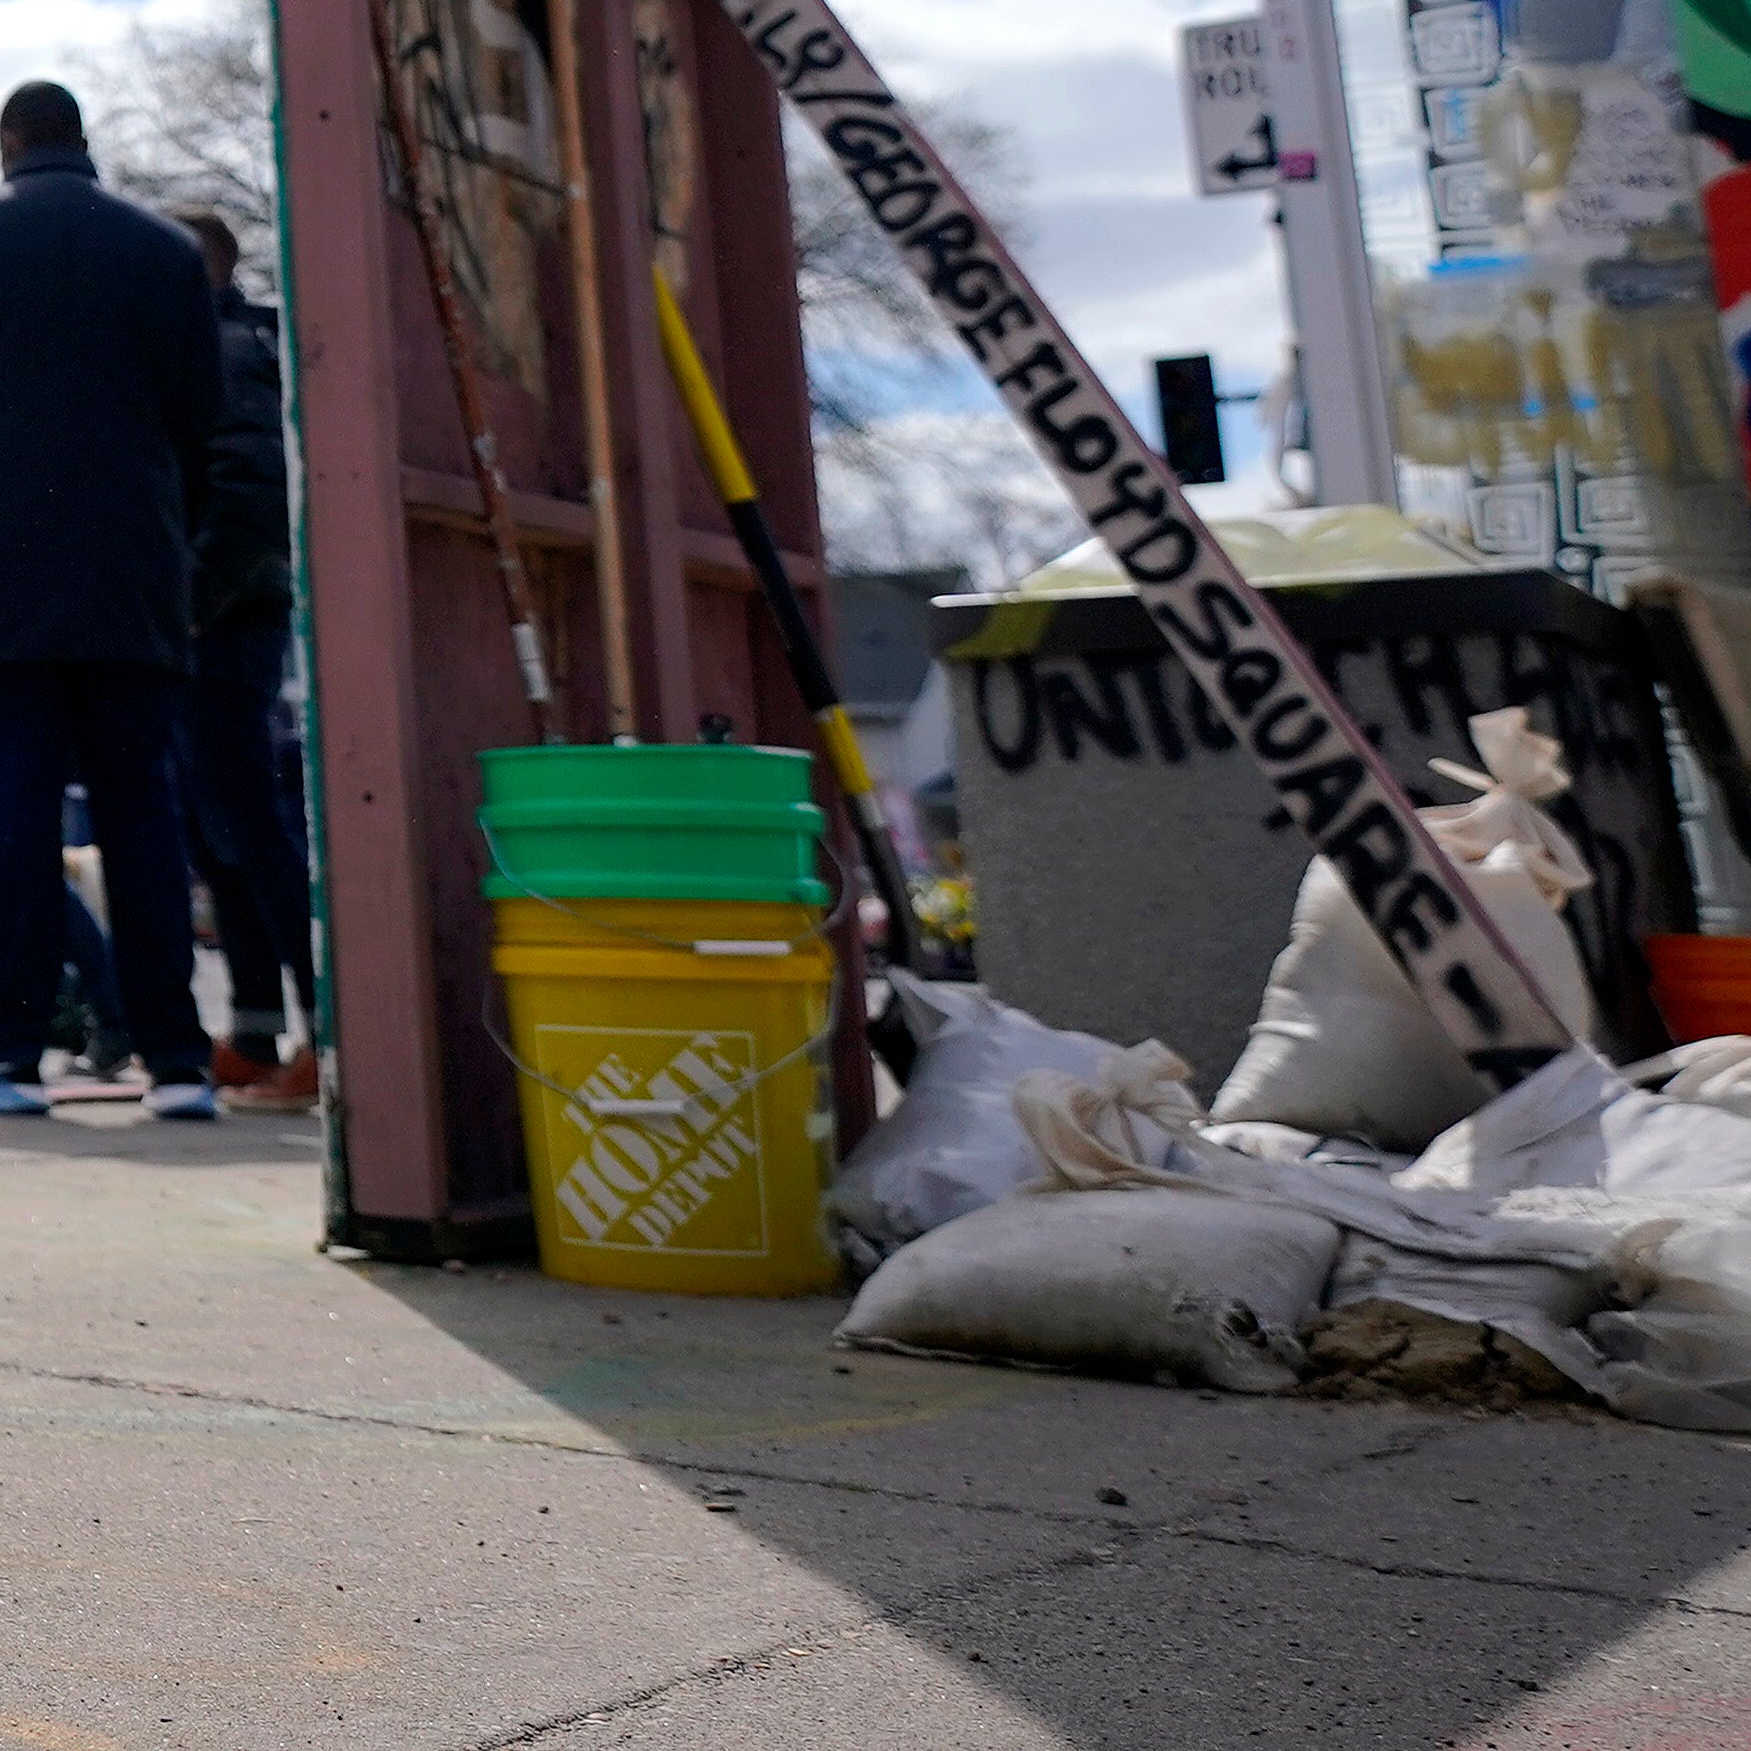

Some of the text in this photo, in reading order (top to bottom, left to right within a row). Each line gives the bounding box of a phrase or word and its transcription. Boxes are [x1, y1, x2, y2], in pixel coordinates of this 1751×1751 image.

[554, 1034, 747, 1243] HOME
[562, 1054, 641, 1135] THE
[627, 1117, 763, 1249] DEPOT
